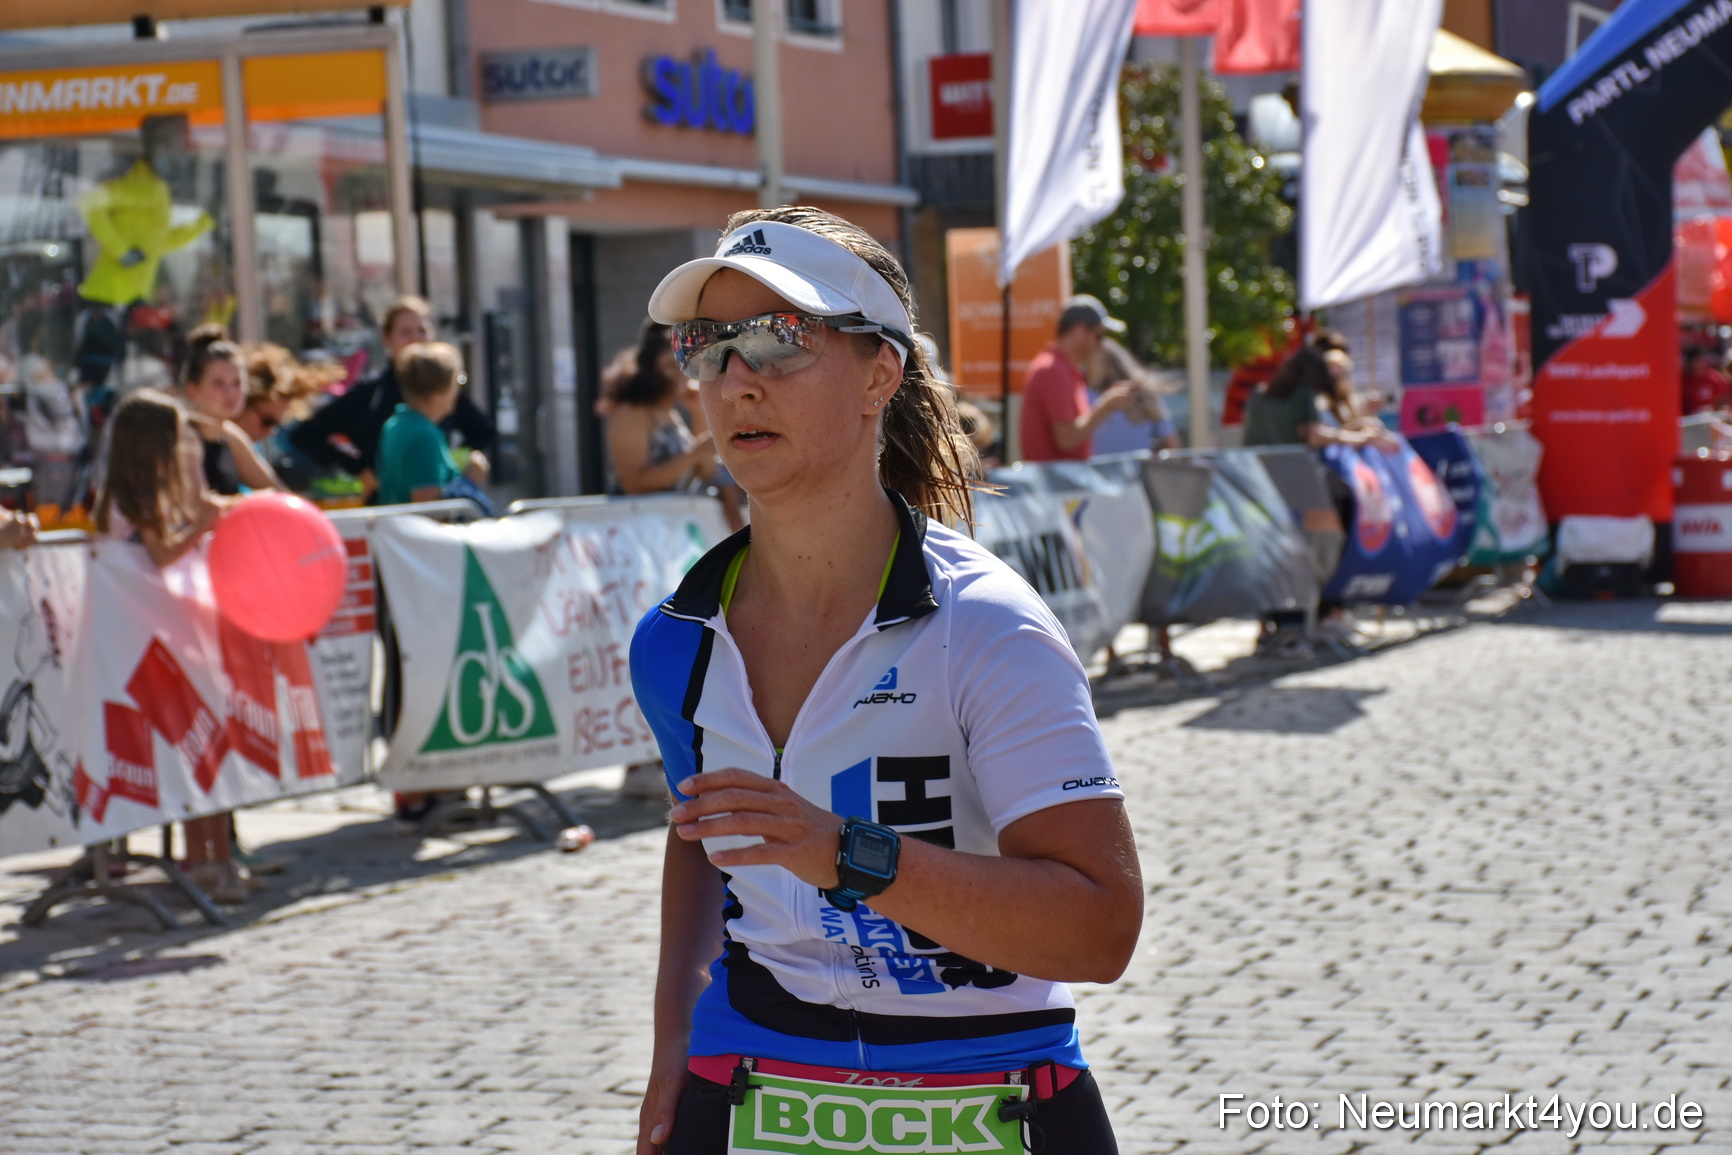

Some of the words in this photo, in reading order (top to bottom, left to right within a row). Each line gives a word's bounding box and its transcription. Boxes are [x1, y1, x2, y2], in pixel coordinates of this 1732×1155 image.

[652, 46, 756, 135] suto
[723, 243, 772, 257] adidas
[757, 1087, 1004, 1152] BOCK
